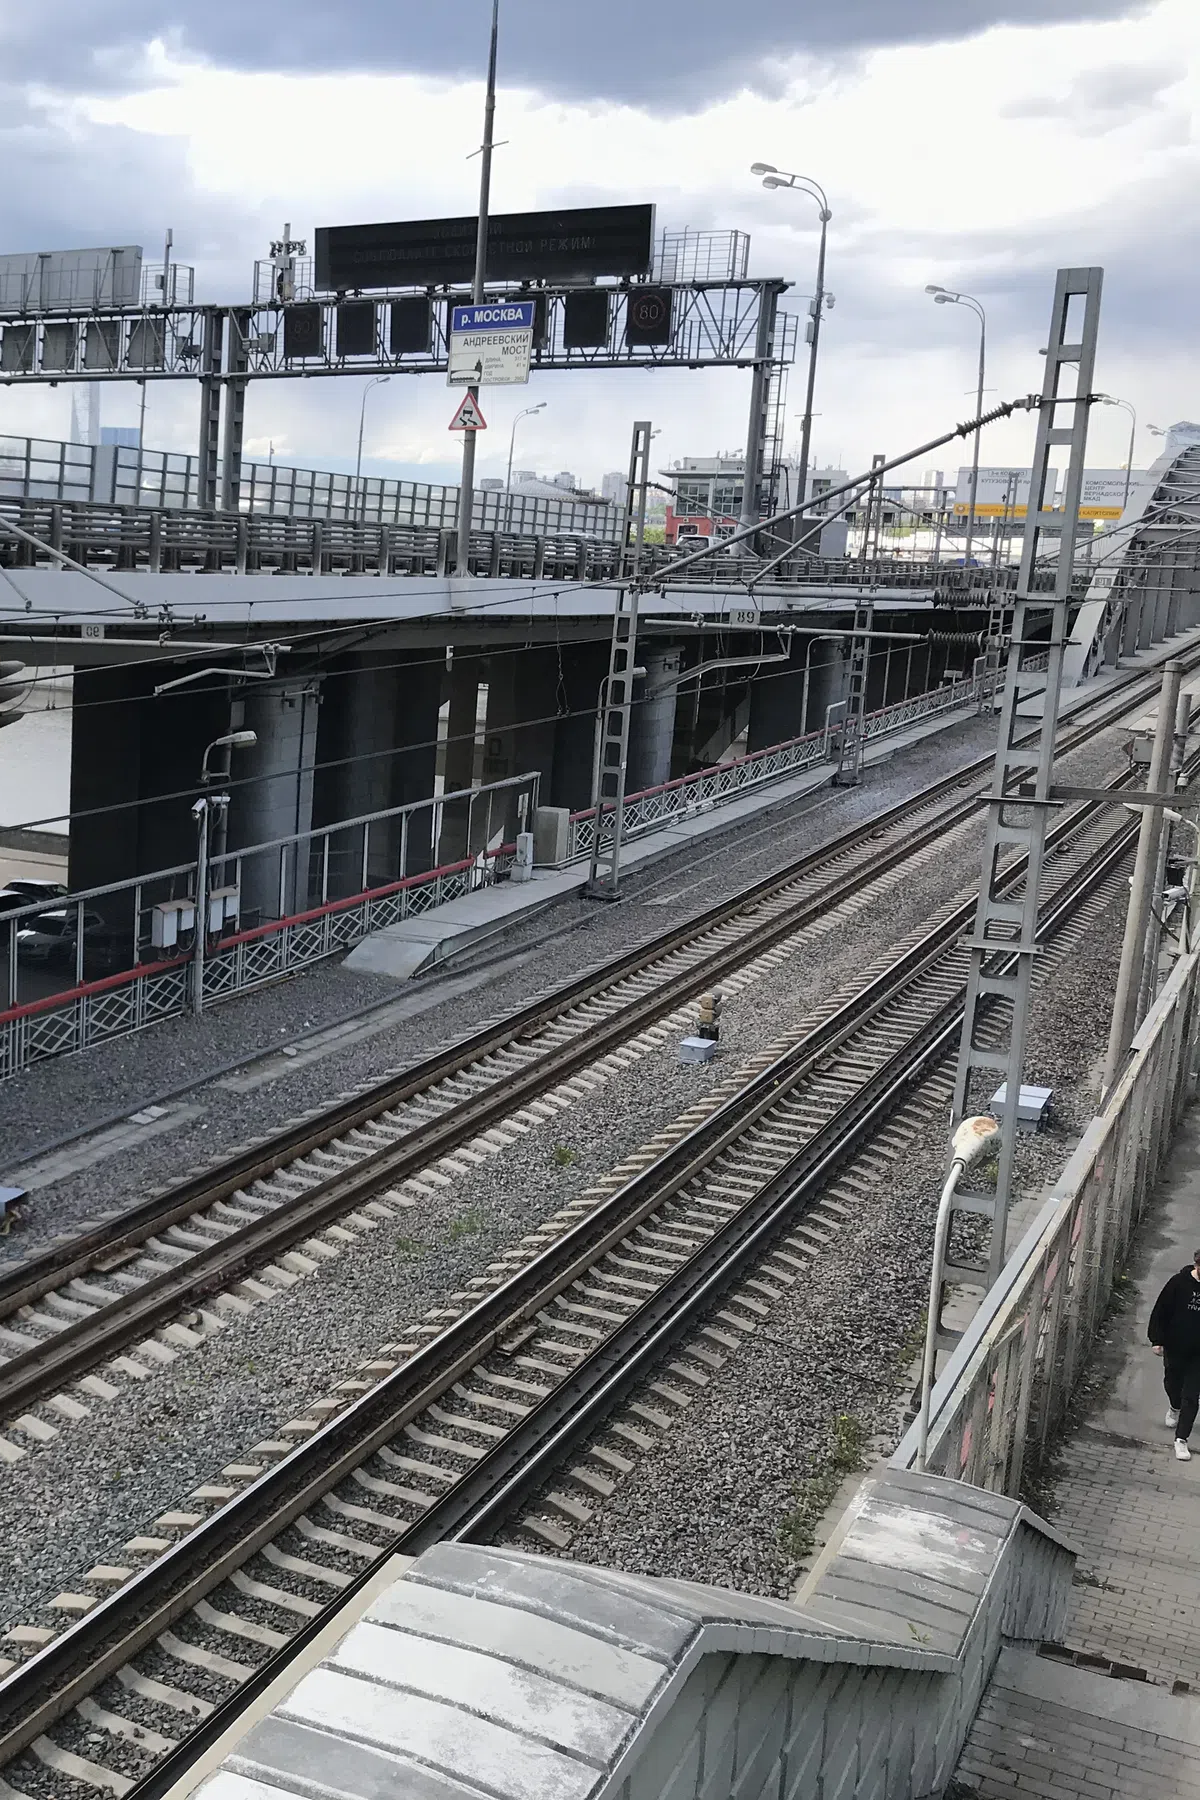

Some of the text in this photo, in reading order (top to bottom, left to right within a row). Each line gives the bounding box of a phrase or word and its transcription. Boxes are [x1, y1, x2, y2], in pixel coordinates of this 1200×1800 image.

[443, 238, 533, 258] СКОРСТНОЙ
[461, 308, 523, 327] р. МОСКВА
[640, 304, 658, 320] 80
[463, 332, 529, 347] АНДРЕЕВСКИЙ
[502, 345, 528, 355] МОСТ
[737, 611, 755, 623] 89
